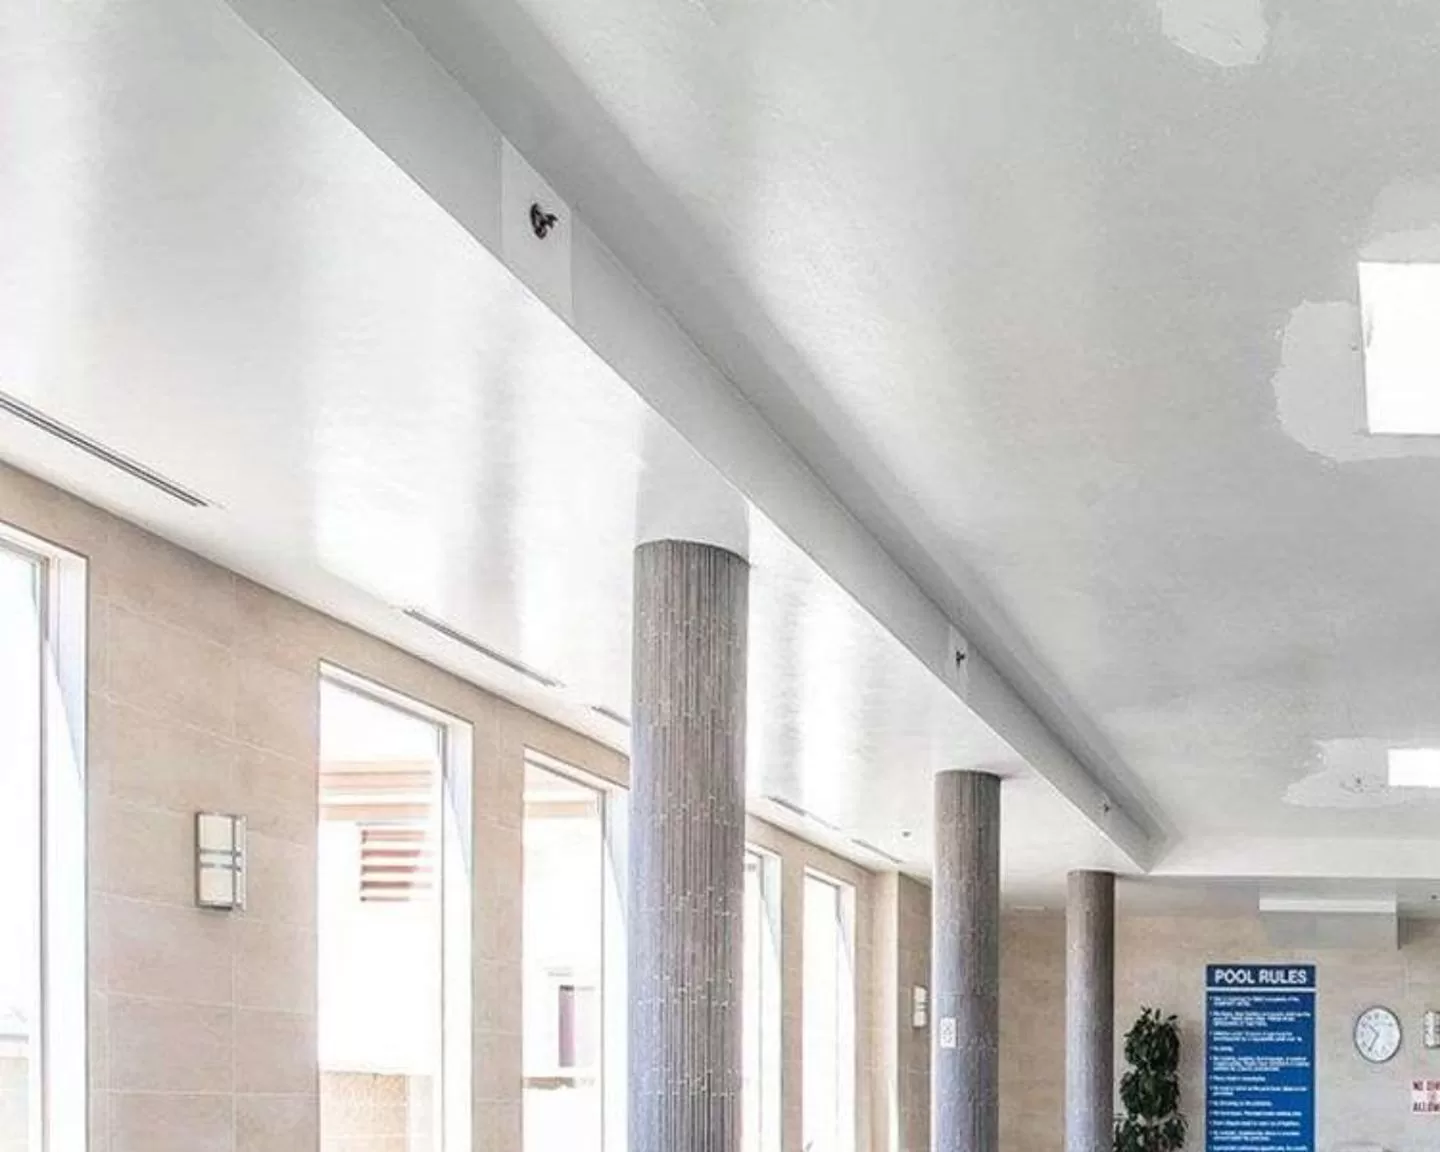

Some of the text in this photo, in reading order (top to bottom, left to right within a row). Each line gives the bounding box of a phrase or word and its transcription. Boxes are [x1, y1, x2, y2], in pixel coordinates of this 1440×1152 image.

[1215, 969, 1307, 984] POOL RULES
[1412, 1080, 1424, 1091] NO
